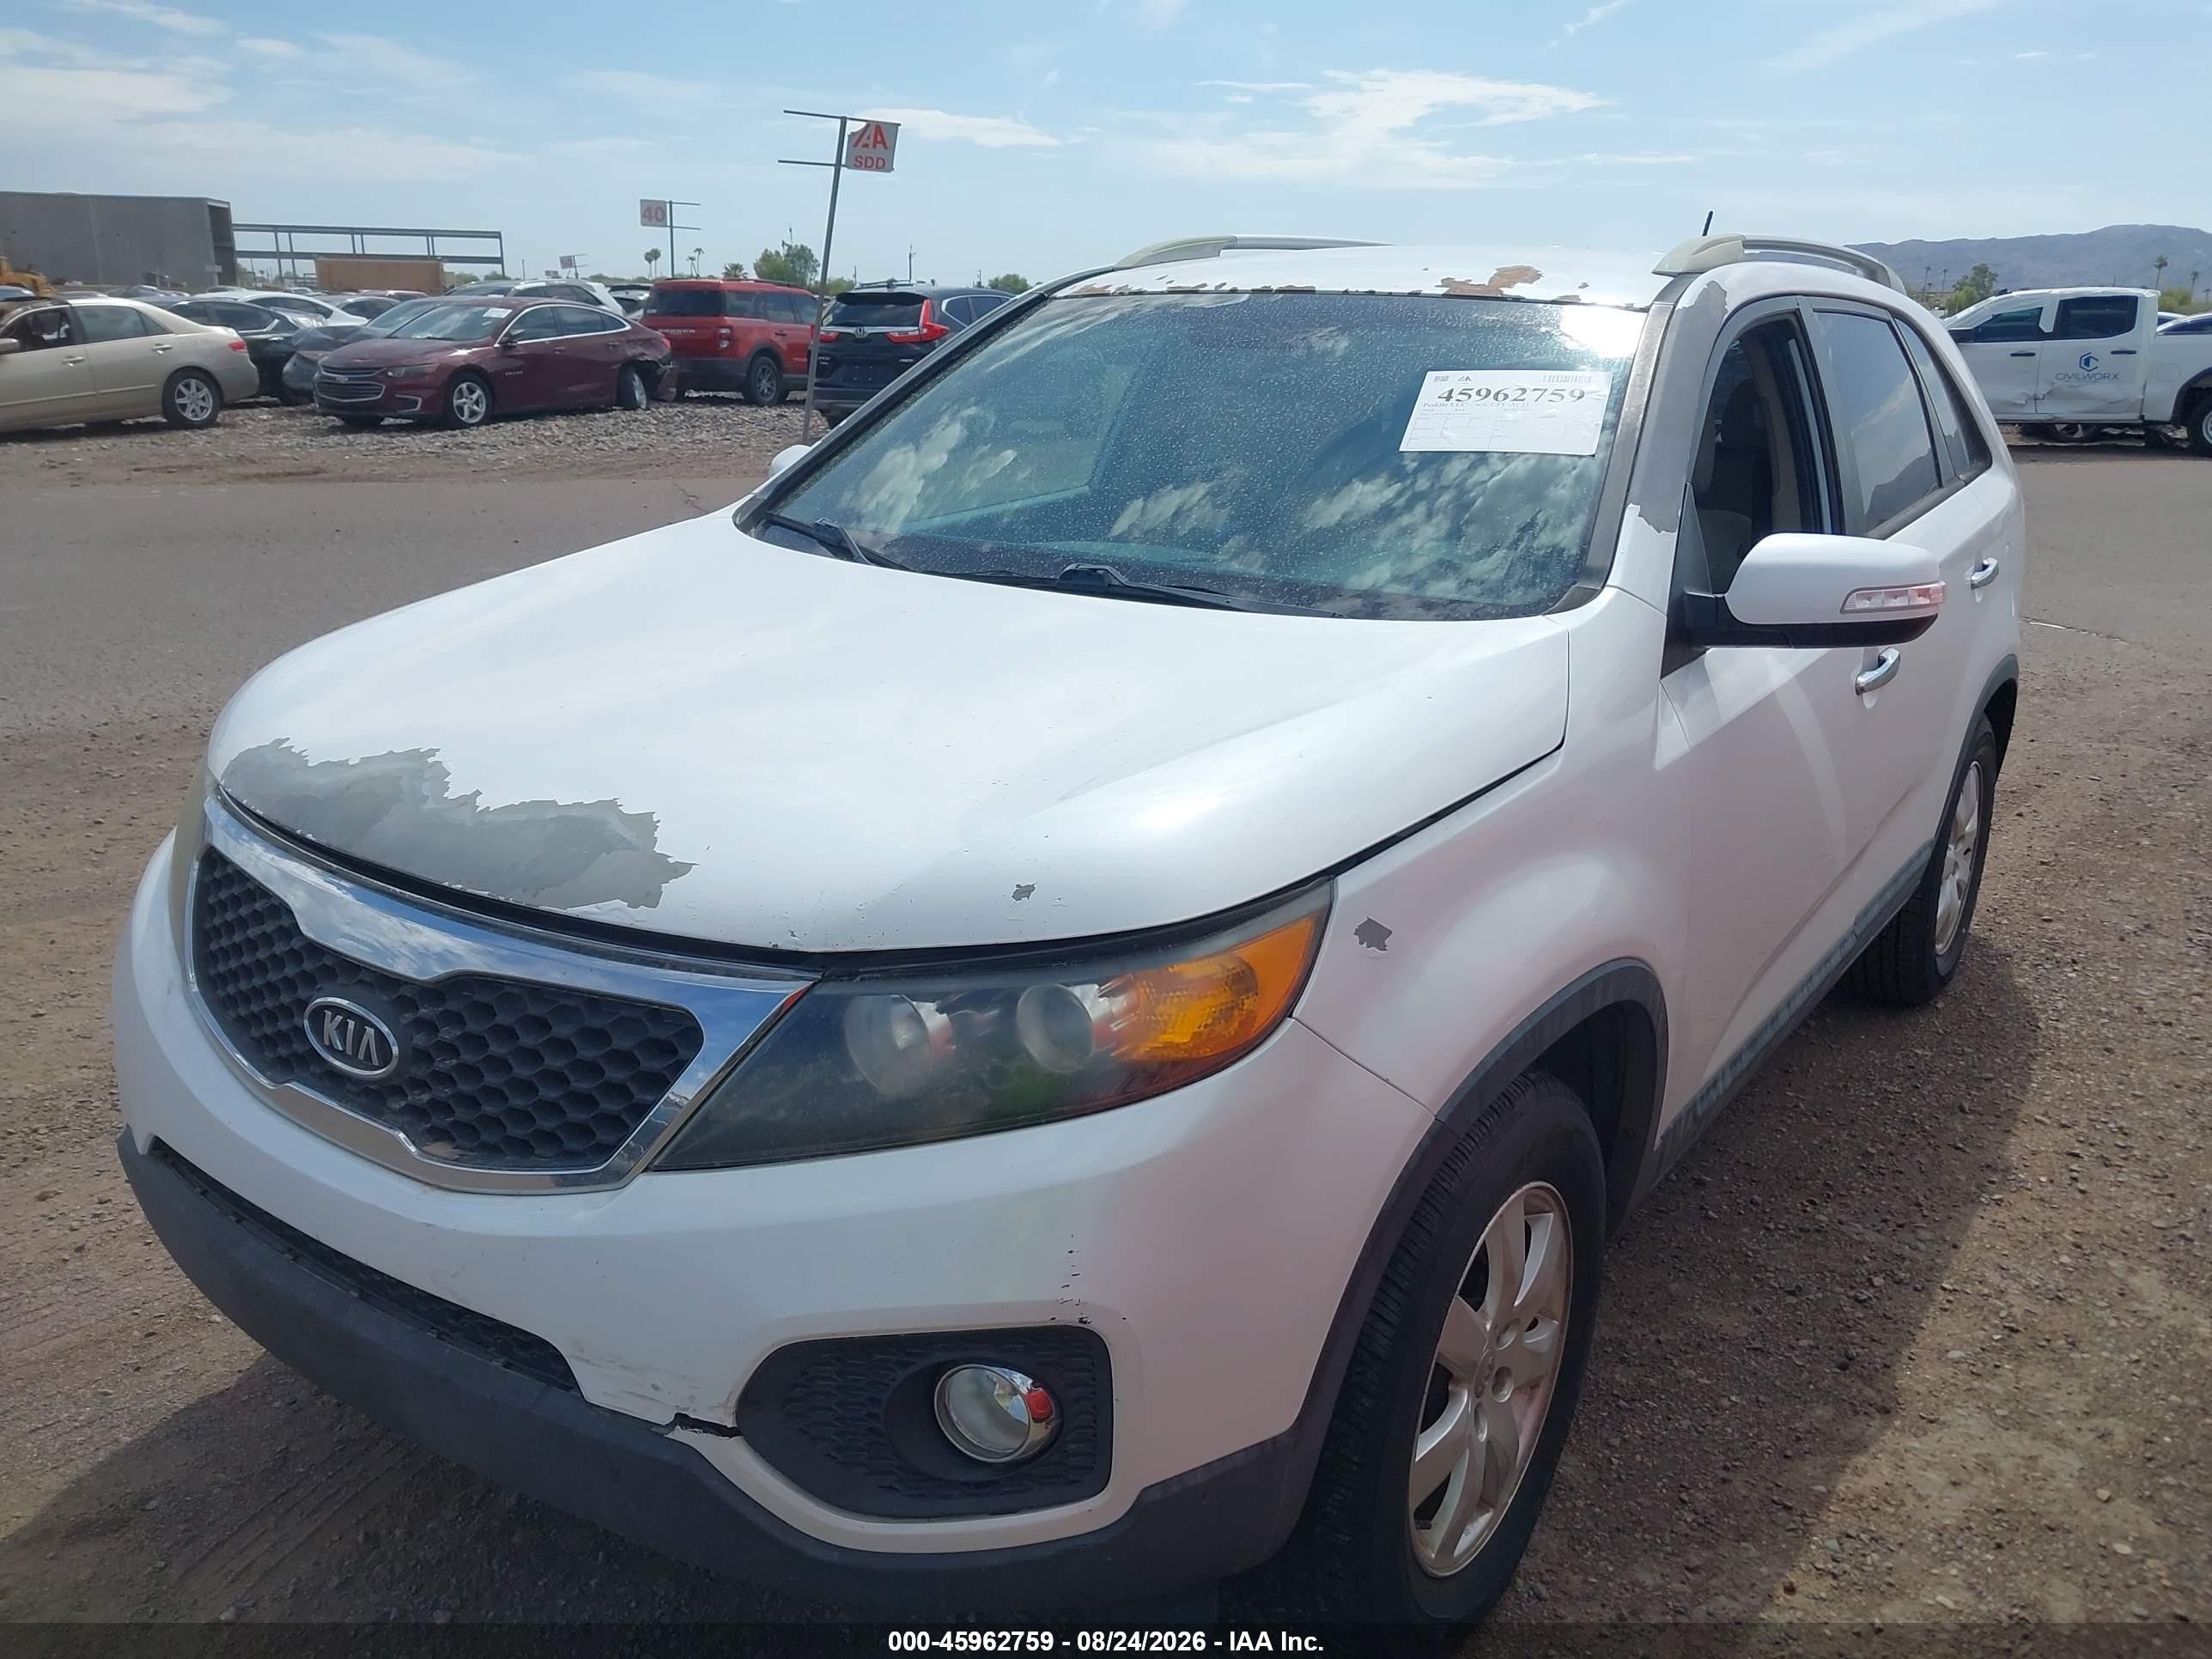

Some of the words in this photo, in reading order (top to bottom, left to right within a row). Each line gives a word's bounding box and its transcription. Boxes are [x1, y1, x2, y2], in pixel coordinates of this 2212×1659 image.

[854, 155, 885, 169] SDD
[641, 206, 665, 222] 40
[2055, 372, 2118, 380] CIVILWORX
[1437, 387, 1585, 403] 45962759
[323, 1009, 380, 1066] KIA
